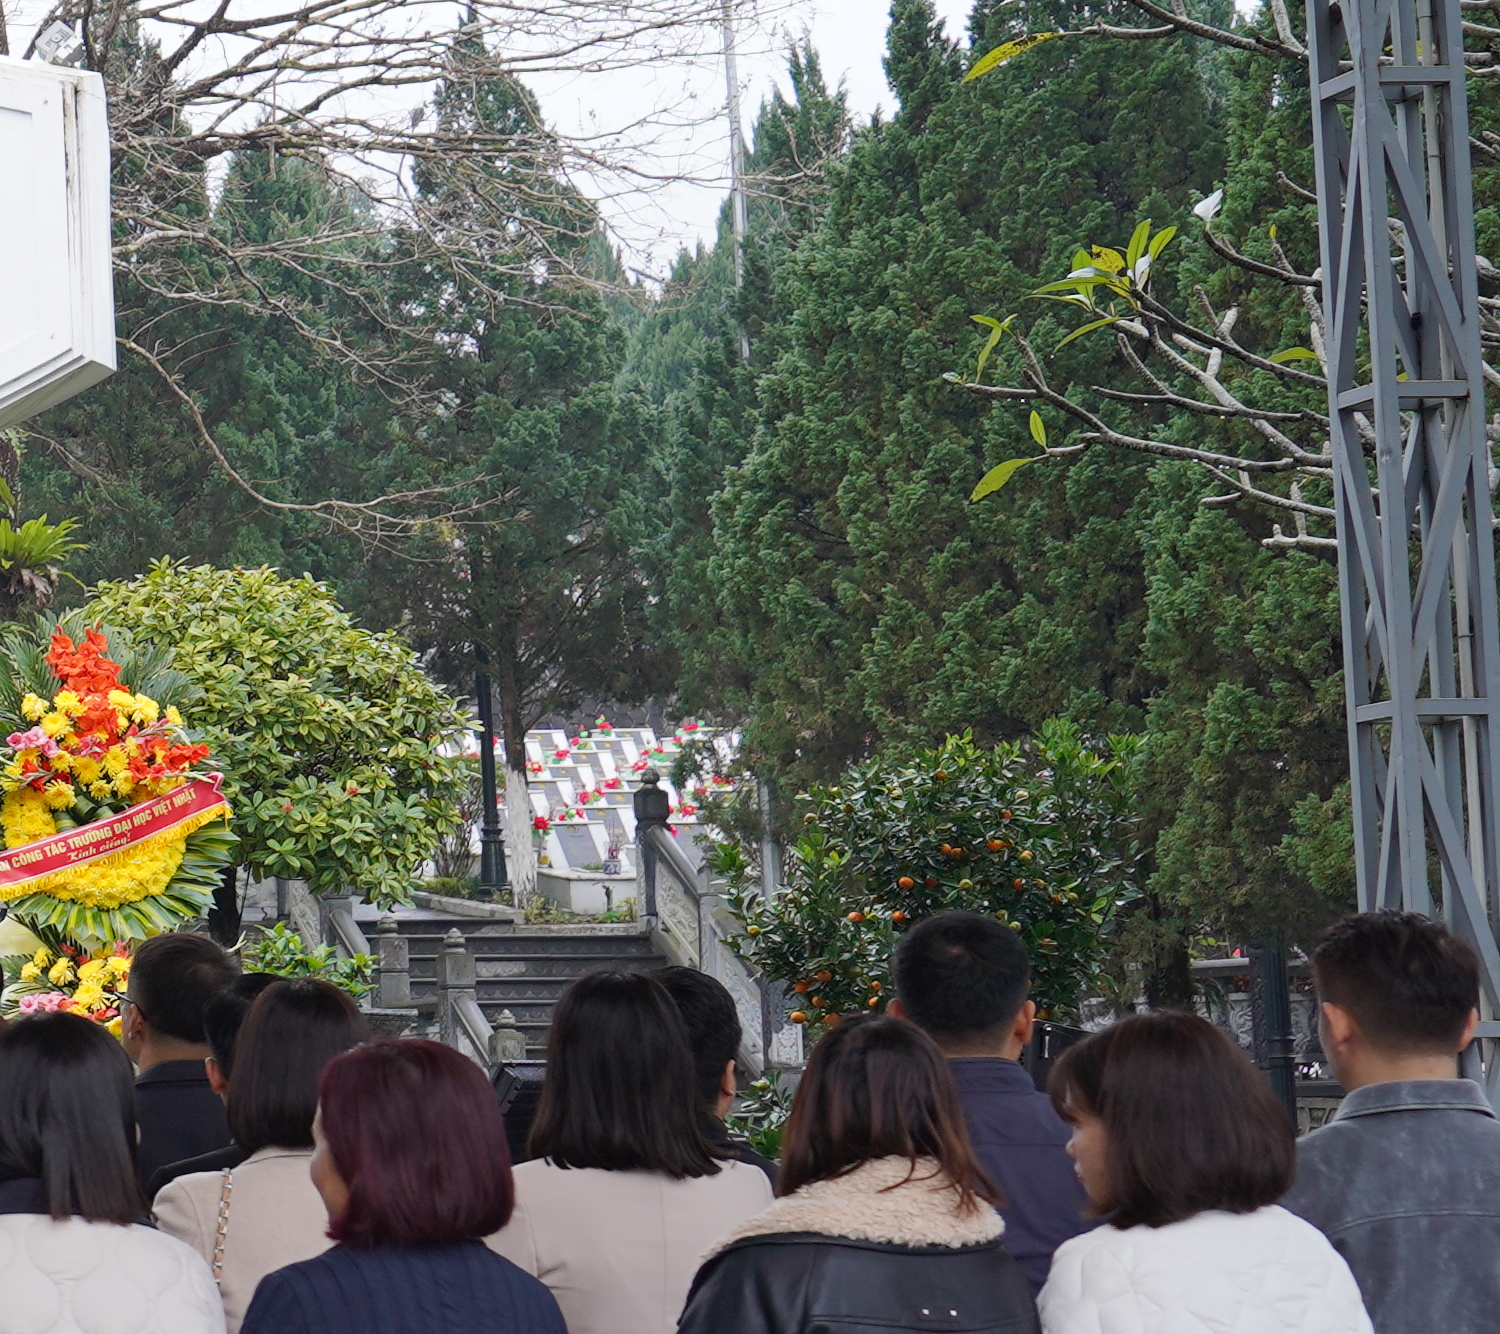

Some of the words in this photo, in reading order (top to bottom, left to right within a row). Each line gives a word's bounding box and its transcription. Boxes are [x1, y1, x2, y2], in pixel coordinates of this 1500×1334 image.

[11, 849, 44, 868] CÔNG
[43, 841, 67, 857] TÁC
[67, 827, 113, 850] TRƯỜNG
[113, 819, 133, 835] ĐẠI
[132, 810, 153, 827] HỌC
[152, 799, 173, 817] VIỆT
[172, 788, 197, 808] NHẬT
[67, 846, 96, 862] Kính
